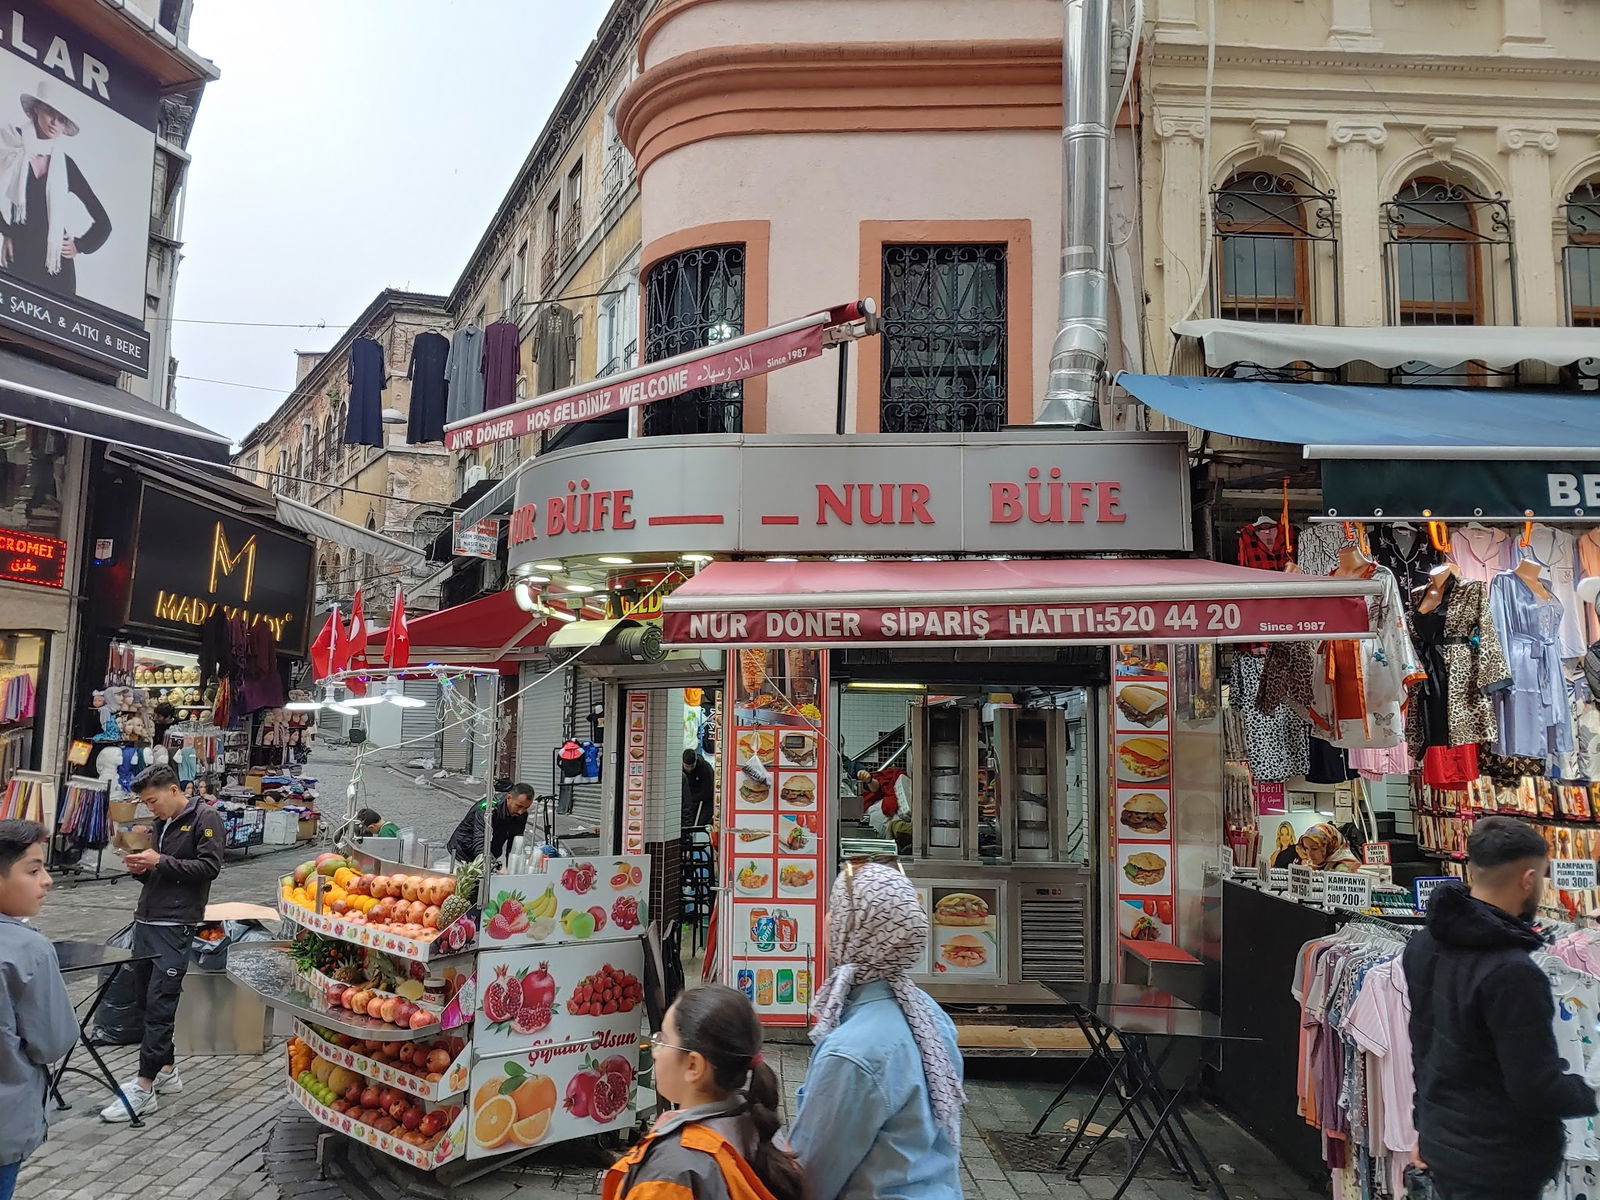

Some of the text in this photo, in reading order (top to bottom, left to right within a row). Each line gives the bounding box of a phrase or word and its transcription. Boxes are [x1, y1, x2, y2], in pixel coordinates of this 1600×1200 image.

[0, 10, 110, 101] LAR
[10, 296, 52, 323] ŞAPKA
[58, 316, 66, 328] &
[72, 322, 99, 342] ATKI
[105, 335, 112, 346] &
[116, 338, 142, 358] BERE
[767, 347, 808, 368] Since 1987
[451, 369, 689, 450] NUR DÖNER HOŞ GELDİNİZ WELCOME
[815, 466, 1127, 525] NUR BÜFE
[507, 478, 637, 550] NUR BÜFE
[208, 521, 256, 602] M
[689, 613, 748, 639] NUR
[766, 608, 862, 638] DÖNER
[880, 604, 990, 640] SİPARİŞ
[1164, 604, 1199, 631] 44
[1207, 603, 1241, 630] 20
[1259, 620, 1327, 632] Since 1987
[1260, 784, 1281, 793] Beril
[1557, 862, 1594, 870] KAMPANYA
[1328, 876, 1366, 886] KAMPANYA
[1557, 877, 1570, 886] 400
[1327, 893, 1341, 904] 300
